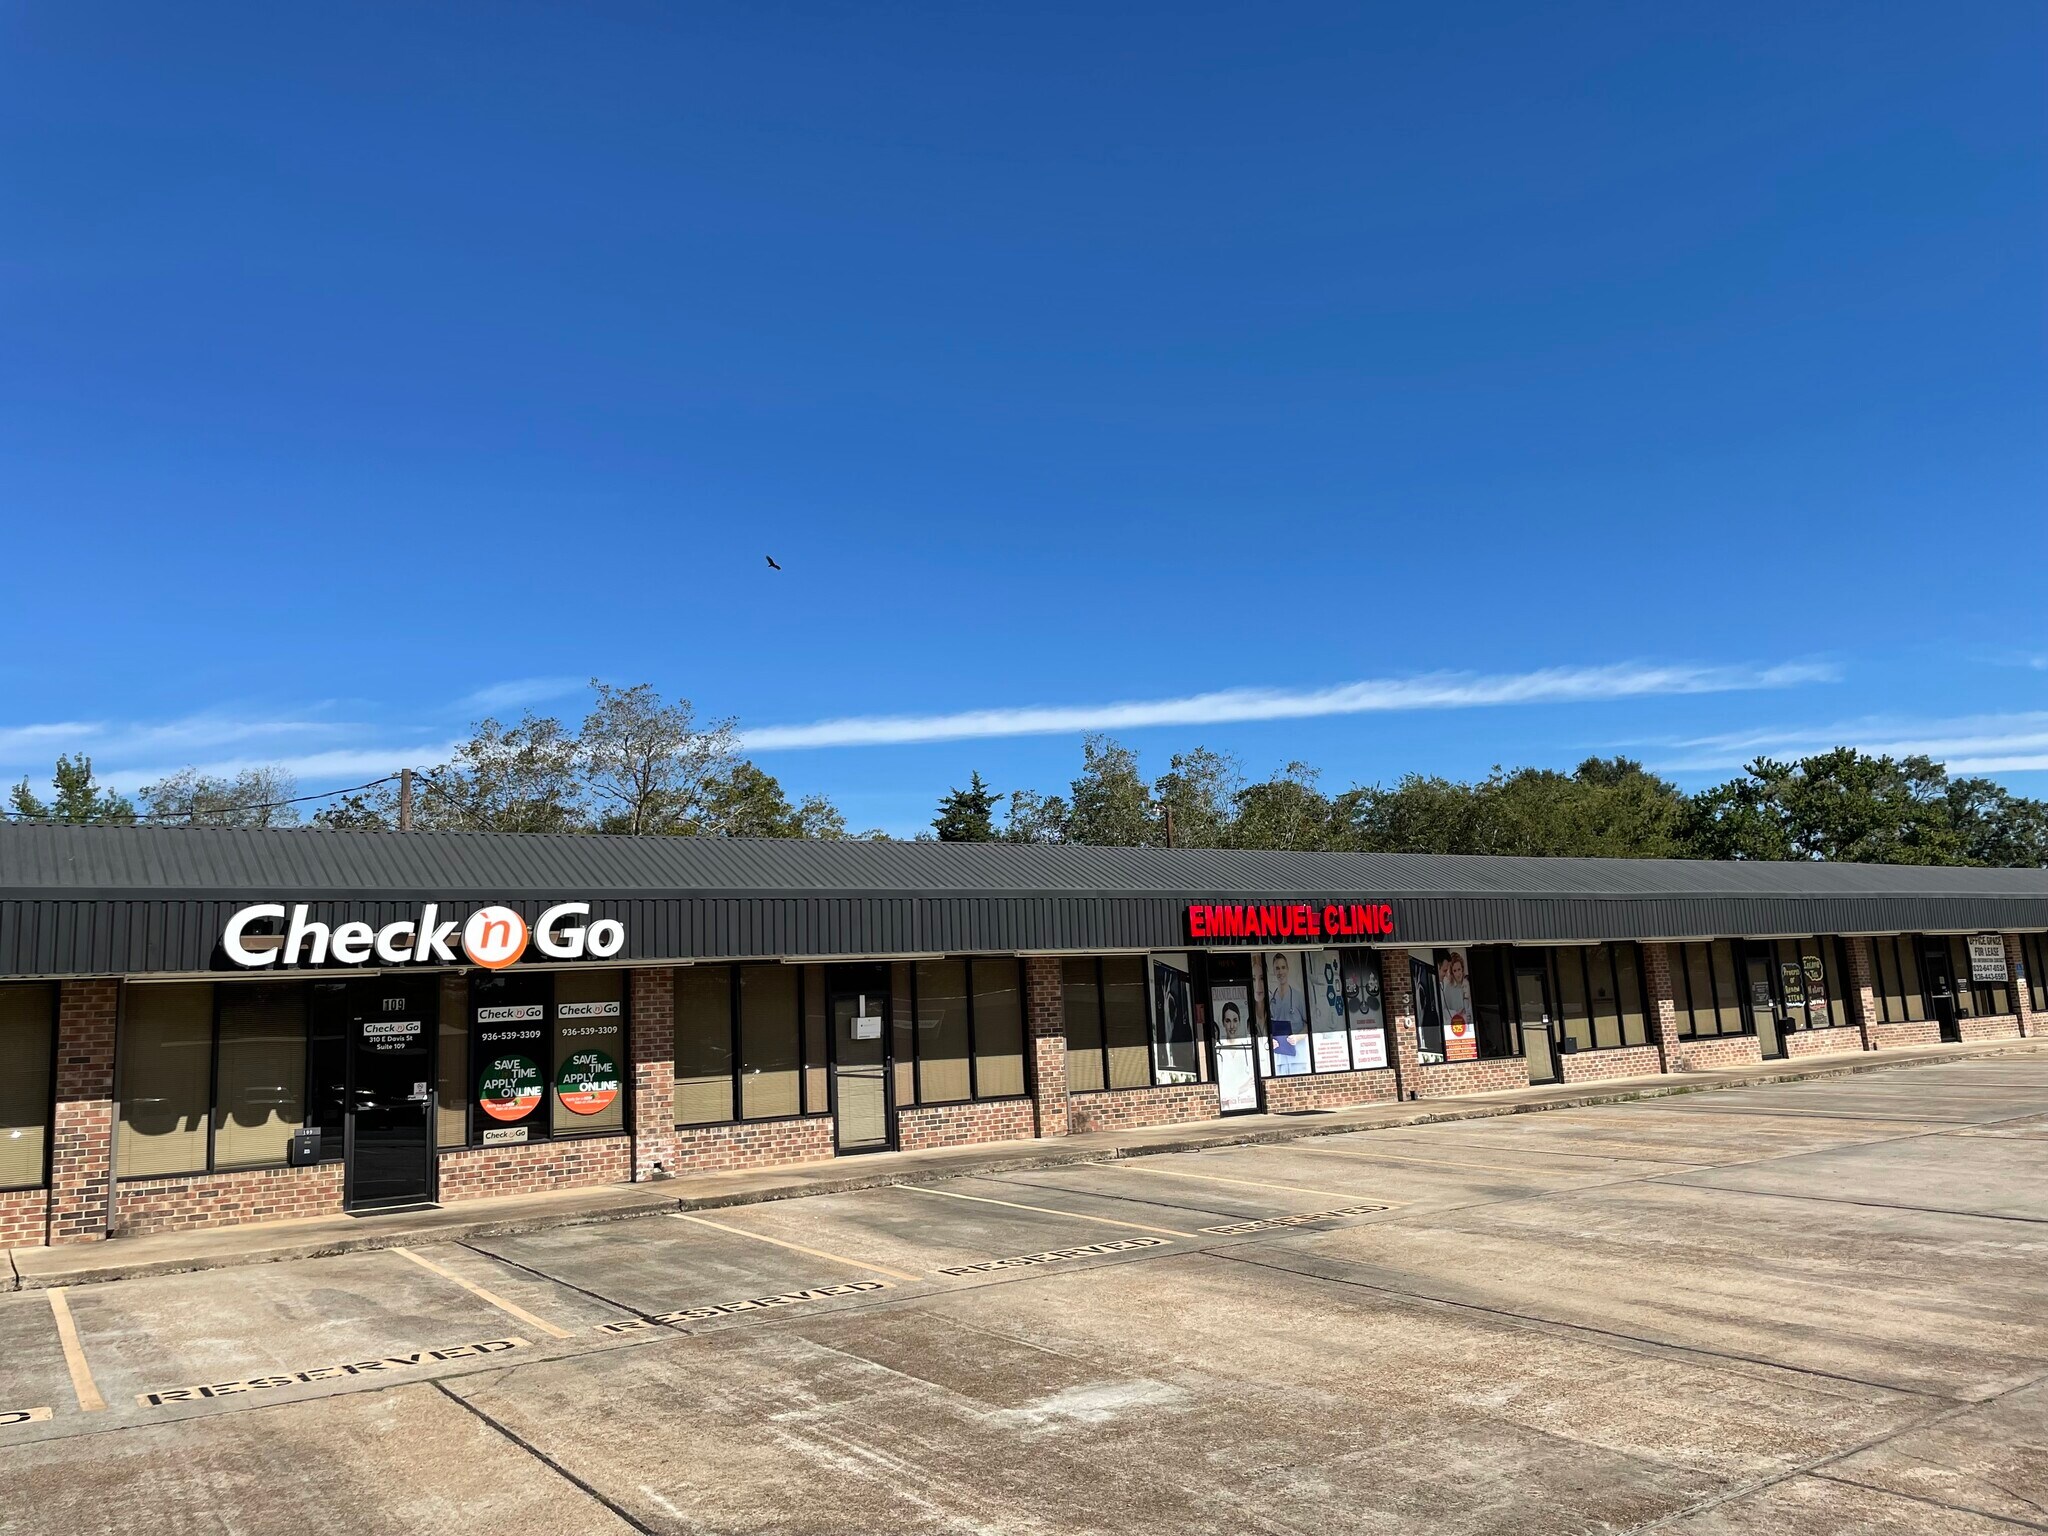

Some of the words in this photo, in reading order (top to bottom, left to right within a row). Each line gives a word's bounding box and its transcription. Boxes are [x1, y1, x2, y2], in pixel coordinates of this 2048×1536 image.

[1189, 905, 1320, 937] EMMANUEL
[1324, 904, 1393, 936] CLINIC
[223, 903, 459, 967] Check
[533, 902, 625, 959] Go
[1969, 936, 1986, 945] OFFICE
[1987, 936, 2002, 945] SPACE
[1974, 947, 1984, 956] FOR
[1985, 947, 2000, 956] LEASE
[383, 998, 405, 1011] 109
[560, 1004, 592, 1015] Check
[604, 1004, 619, 1013] Go
[479, 1008, 514, 1019] Check
[526, 1007, 541, 1017] Go
[365, 1023, 395, 1033] Check
[405, 1022, 419, 1031] Go
[562, 1026, 618, 1036] 936-539-3309
[481, 1030, 541, 1041] 936-539-3309
[494, 1060, 521, 1070] SAVE
[573, 1054, 598, 1065] SAVE
[511, 1068, 537, 1078] TIME
[589, 1063, 613, 1073] TIME
[483, 1078, 518, 1090] APPLY
[563, 1073, 595, 1084] APPLY
[579, 1080, 618, 1092] ONLINE
[501, 1086, 542, 1098] ONLINE
[485, 1131, 508, 1139] Check
[1210, 1203, 1390, 1236] RESERVED
[937, 1237, 1162, 1277] RESERVED
[603, 1281, 885, 1333] RESERVED
[147, 1340, 516, 1406] RESERVED
